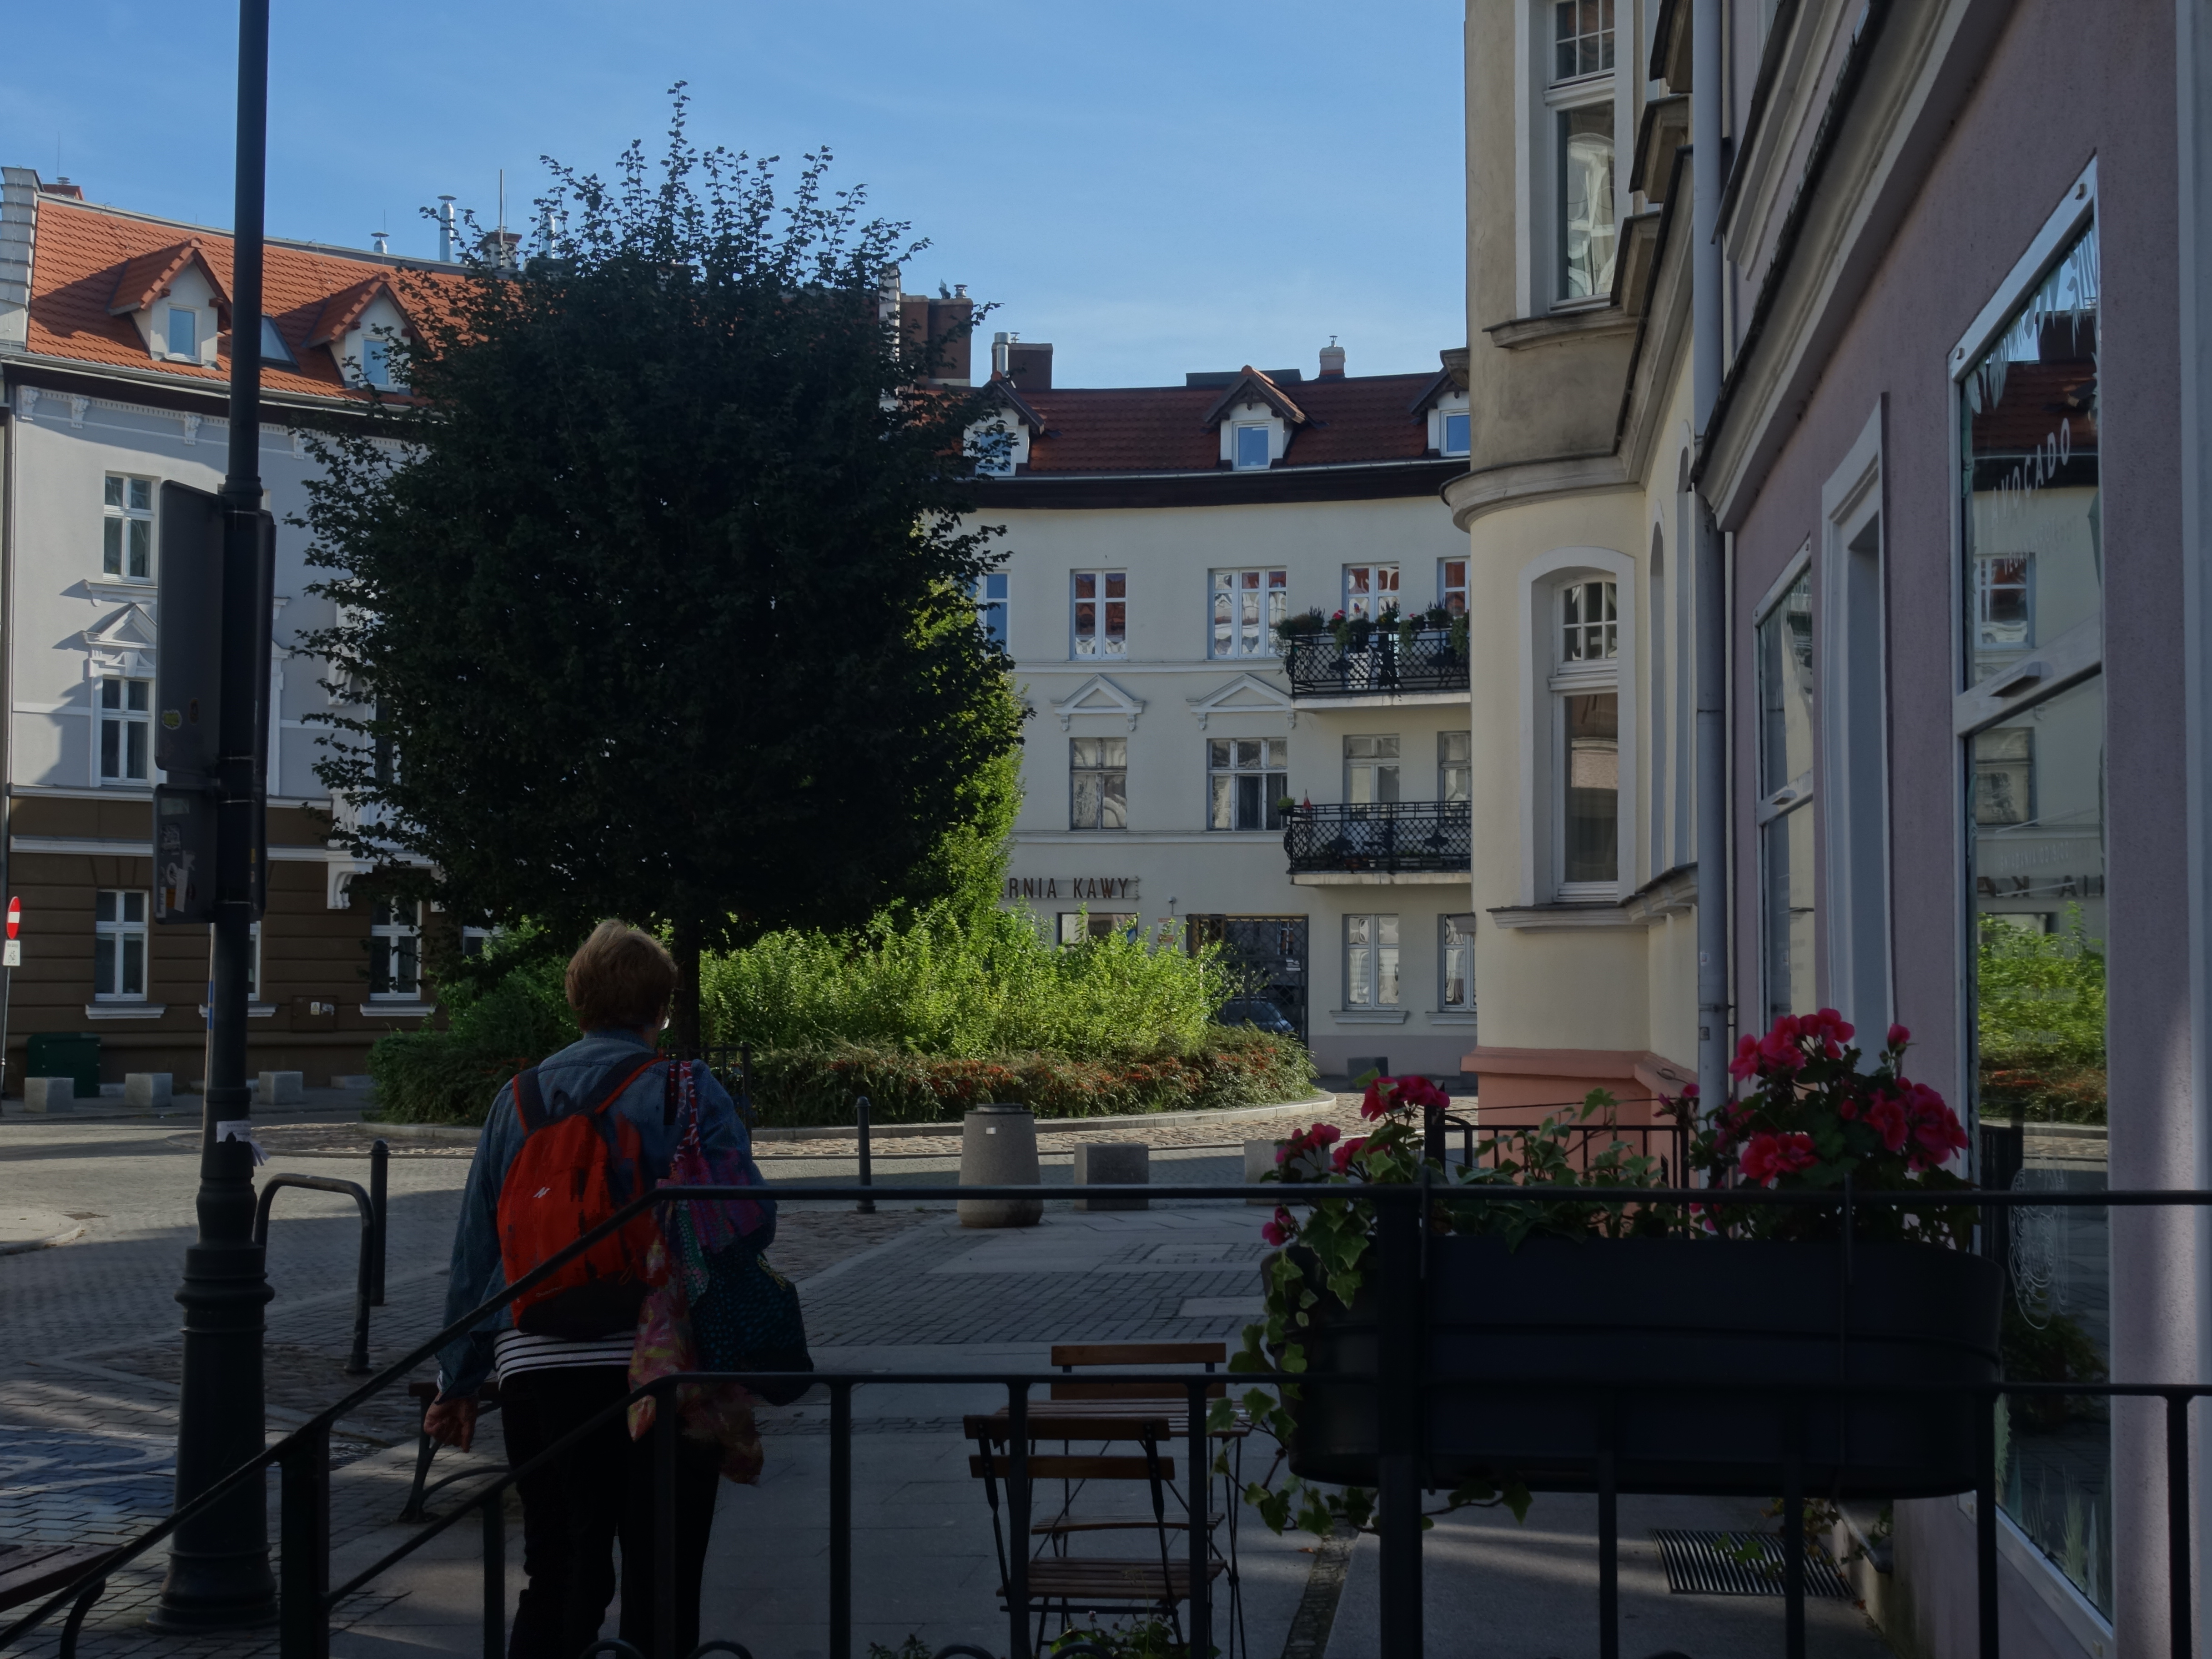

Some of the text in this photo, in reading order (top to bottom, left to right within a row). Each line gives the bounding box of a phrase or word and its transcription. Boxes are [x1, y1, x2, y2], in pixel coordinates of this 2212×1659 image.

[1993, 417, 2071, 525] AVOCADO
[1001, 877, 1129, 899] RNIA KAWY
